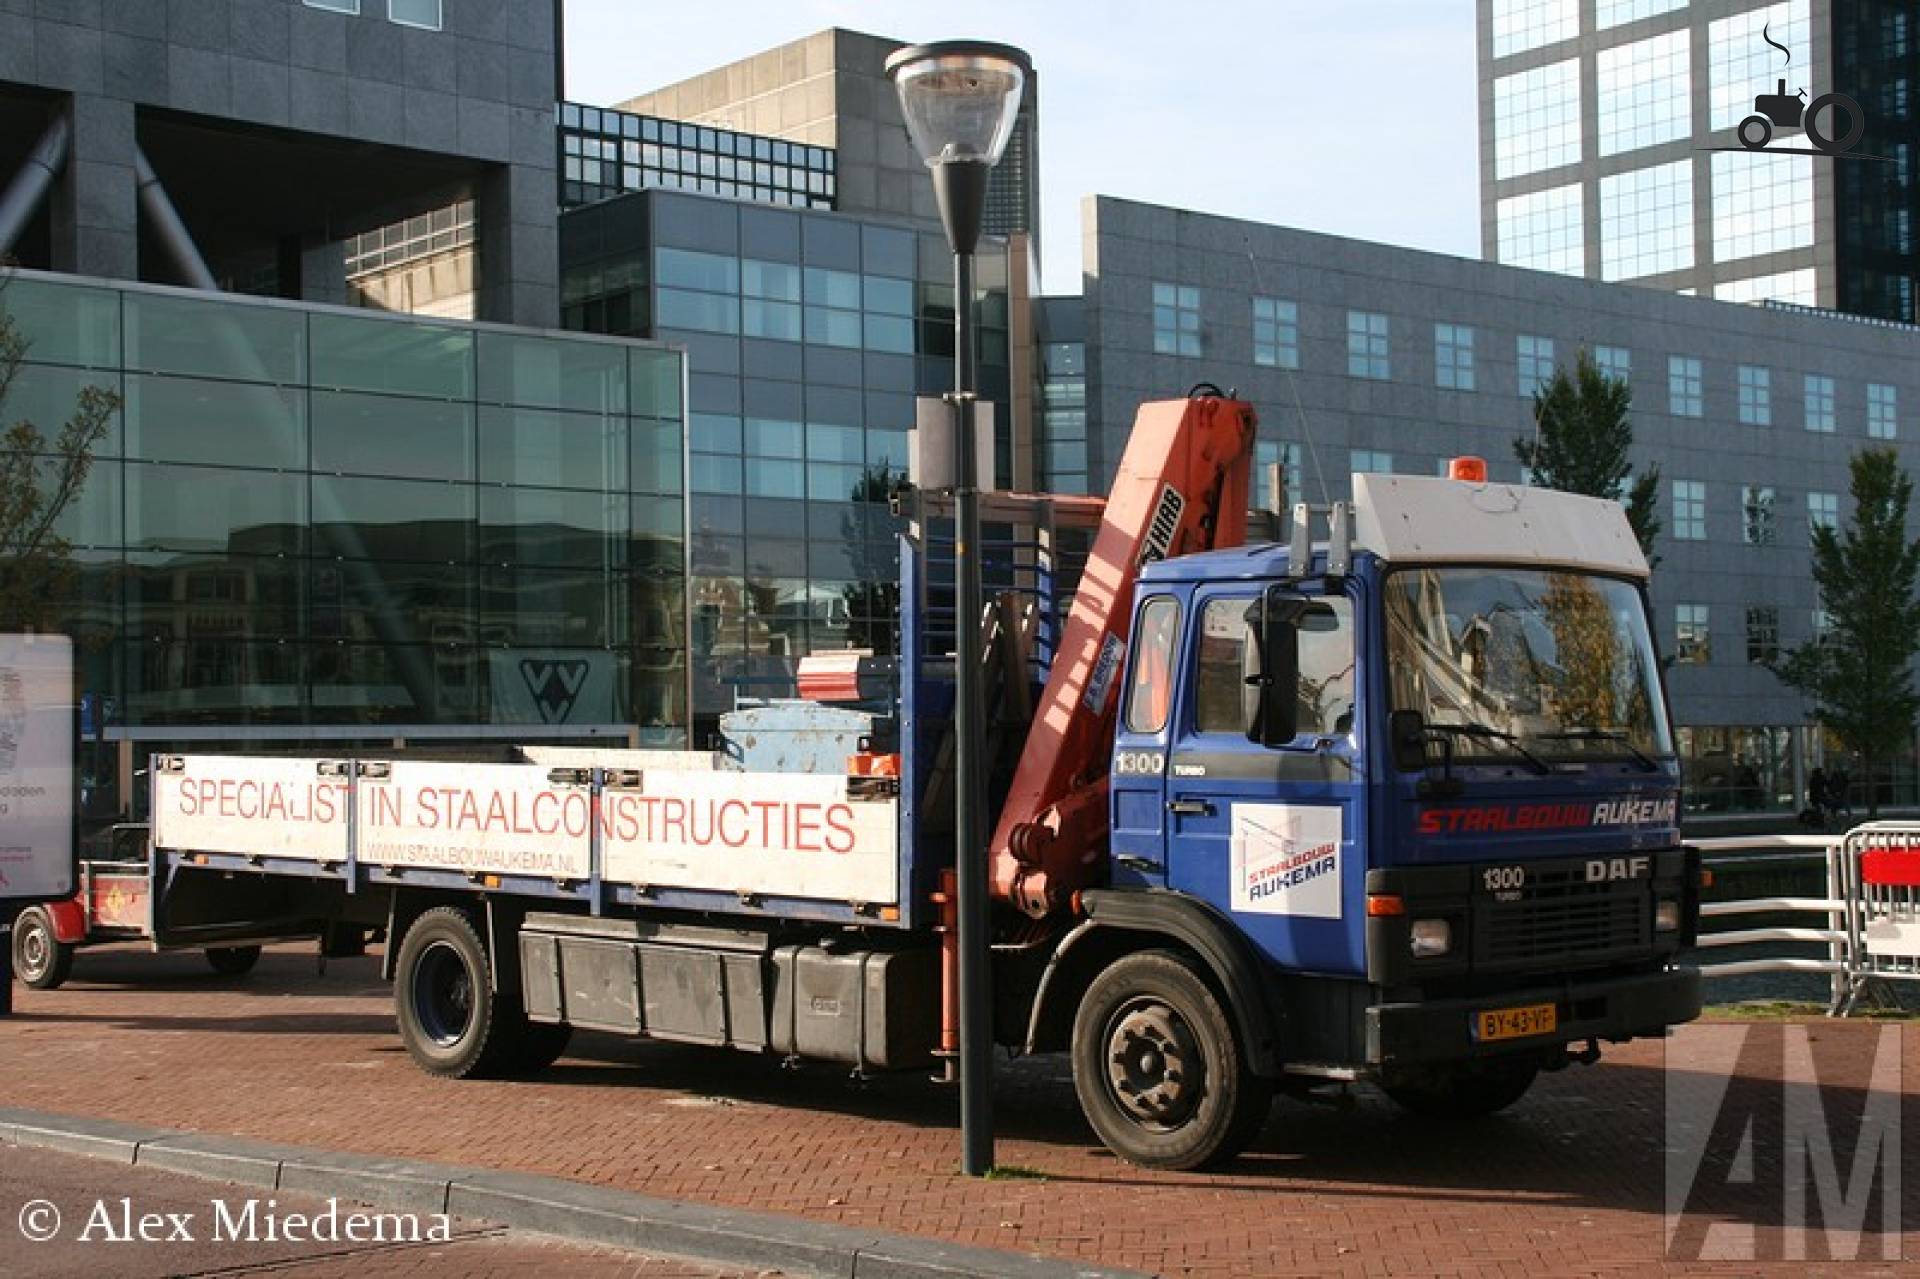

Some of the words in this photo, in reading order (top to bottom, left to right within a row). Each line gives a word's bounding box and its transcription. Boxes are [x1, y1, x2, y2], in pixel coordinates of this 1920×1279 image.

[1115, 751, 1165, 774] 1300
[179, 777, 355, 824] SPECIALIST
[370, 786, 402, 828] IN
[416, 785, 857, 854] STAALCONSTRUCTIES
[1420, 806, 1590, 832] STAALBOUW
[1594, 799, 1676, 825] AUKEMA
[1249, 842, 1336, 884] STAALBOUW
[1481, 865, 1525, 891] 1300
[1584, 856, 1651, 882] DAF
[1249, 855, 1337, 902] AUKEMA
[1485, 1008, 1553, 1036] BY-43-VF
